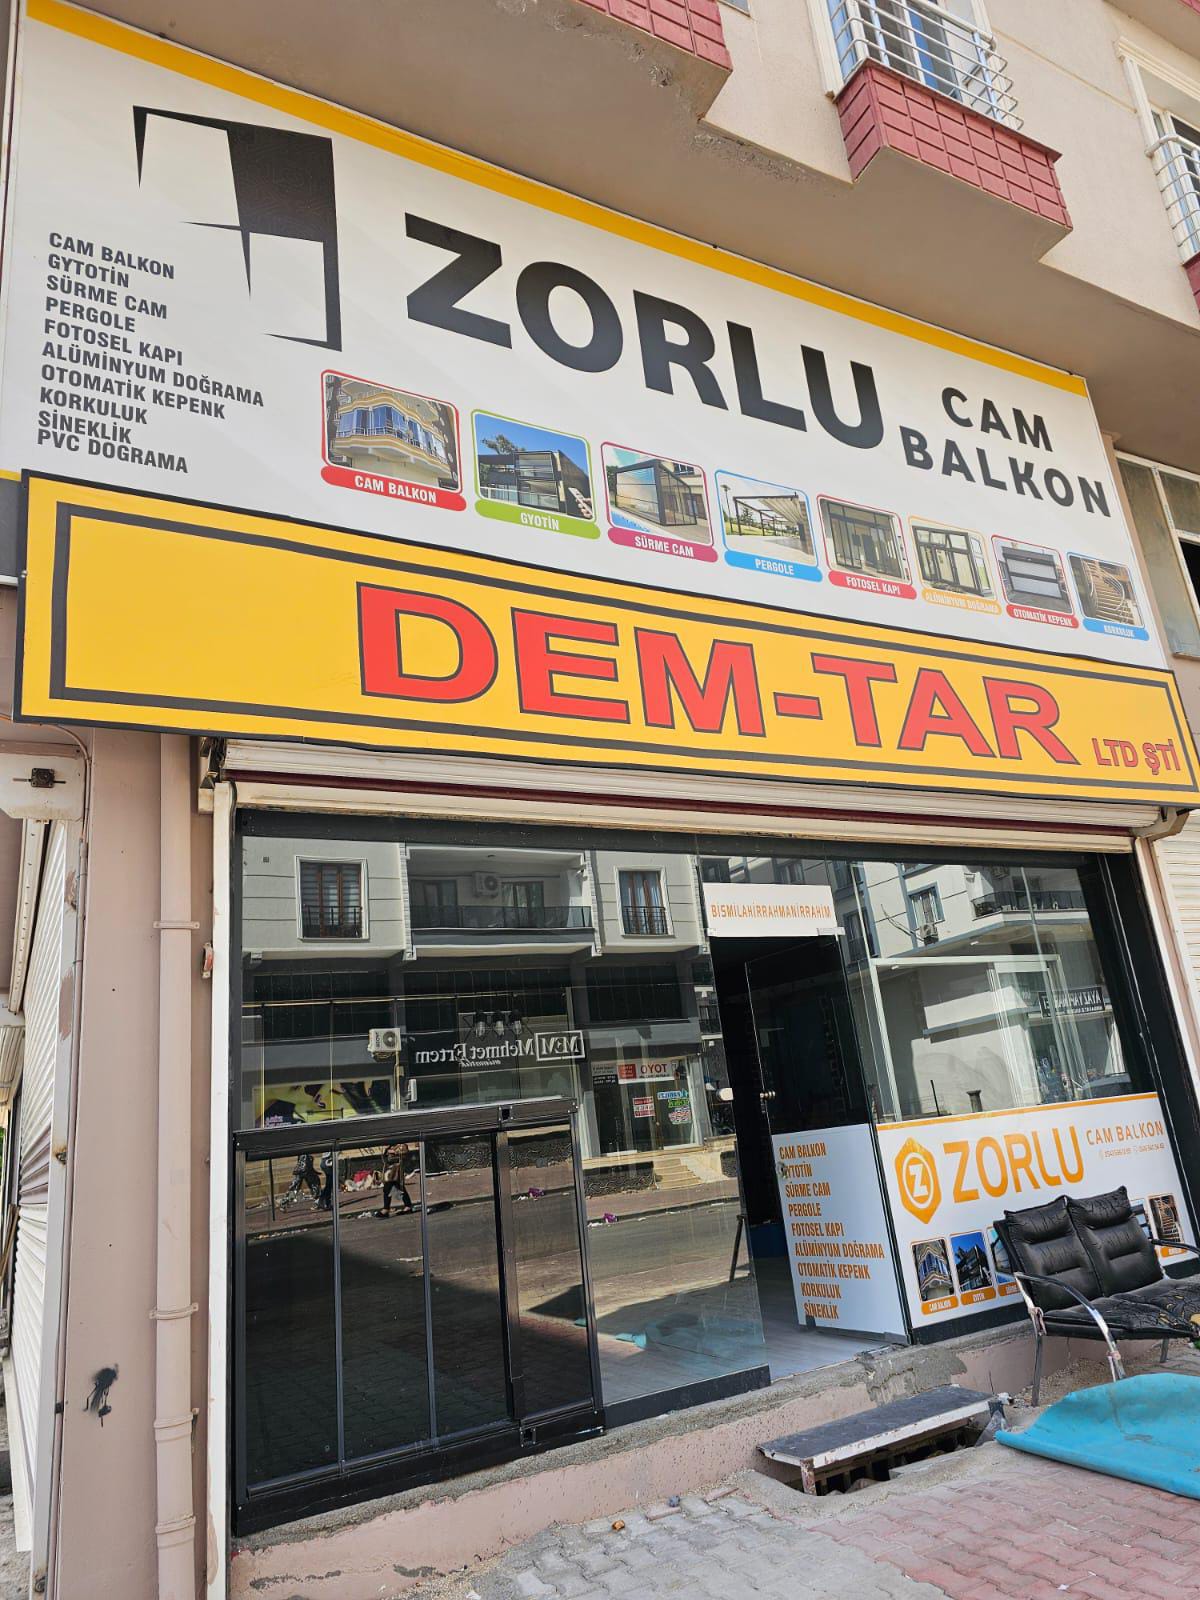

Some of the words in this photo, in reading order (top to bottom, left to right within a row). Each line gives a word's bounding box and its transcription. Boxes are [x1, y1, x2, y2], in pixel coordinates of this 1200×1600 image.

[48, 254, 129, 288] GYTOTİN
[50, 232, 94, 258] CAM
[101, 247, 175, 279] BALKON
[45, 296, 136, 332] PERGOLE
[46, 275, 117, 307] SÜRME
[124, 294, 168, 319] CAM
[44, 318, 132, 353] FOTOSEL
[139, 341, 182, 366] KAPI
[404, 212, 884, 450] ZORLU
[42, 340, 166, 383] ALÜMİNYUM
[173, 373, 264, 407] DOĞRAMA
[40, 387, 148, 424] KORKULUK
[41, 363, 146, 402] OTOMATİK
[152, 389, 225, 419] KEPENK
[38, 410, 132, 444] SİNEKLİK
[943, 387, 1053, 452] CAM
[37, 429, 80, 451] PVC
[88, 438, 188, 473] DOGRAMA
[900, 425, 1112, 518] BALKON
[354, 474, 385, 493] CAM
[388, 482, 438, 504] BALKON
[519, 511, 561, 531] GYOTİN
[634, 534, 670, 554] SÜRME
[673, 542, 694, 557] CAM
[754, 557, 795, 576] PERGOLE
[845, 575, 881, 592] FOTOSEL
[882, 581, 901, 595] KAPI
[1013, 608, 1048, 623] OTOMATİK
[356, 582, 1081, 766] DEM-TAR
[1091, 737, 1138, 768] LTD
[1142, 738, 1181, 775] ŞTİ
[1086, 1127, 1113, 1145] CAM
[1116, 1120, 1164, 1142] BALKON
[779, 1145, 796, 1161] CAM
[797, 1142, 827, 1158] BALKON
[943, 1126, 1084, 1204] ZORLU
[785, 1182, 811, 1198] SÜRME
[813, 1181, 831, 1197] CAM
[908, 1163, 929, 1198] Z
[788, 1202, 822, 1218] PERGOLE
[791, 1222, 824, 1237] FOTOSEL
[826, 1221, 845, 1237] KAPI
[794, 1239, 841, 1258] ALÜMİNYUM
[842, 1240, 885, 1259] DOĞRAMA
[797, 1259, 837, 1278] OTOMATİK
[838, 1263, 871, 1280] KEPENK
[801, 1282, 842, 1299] KORKULUK
[804, 1300, 839, 1320] SİNEKLİK
